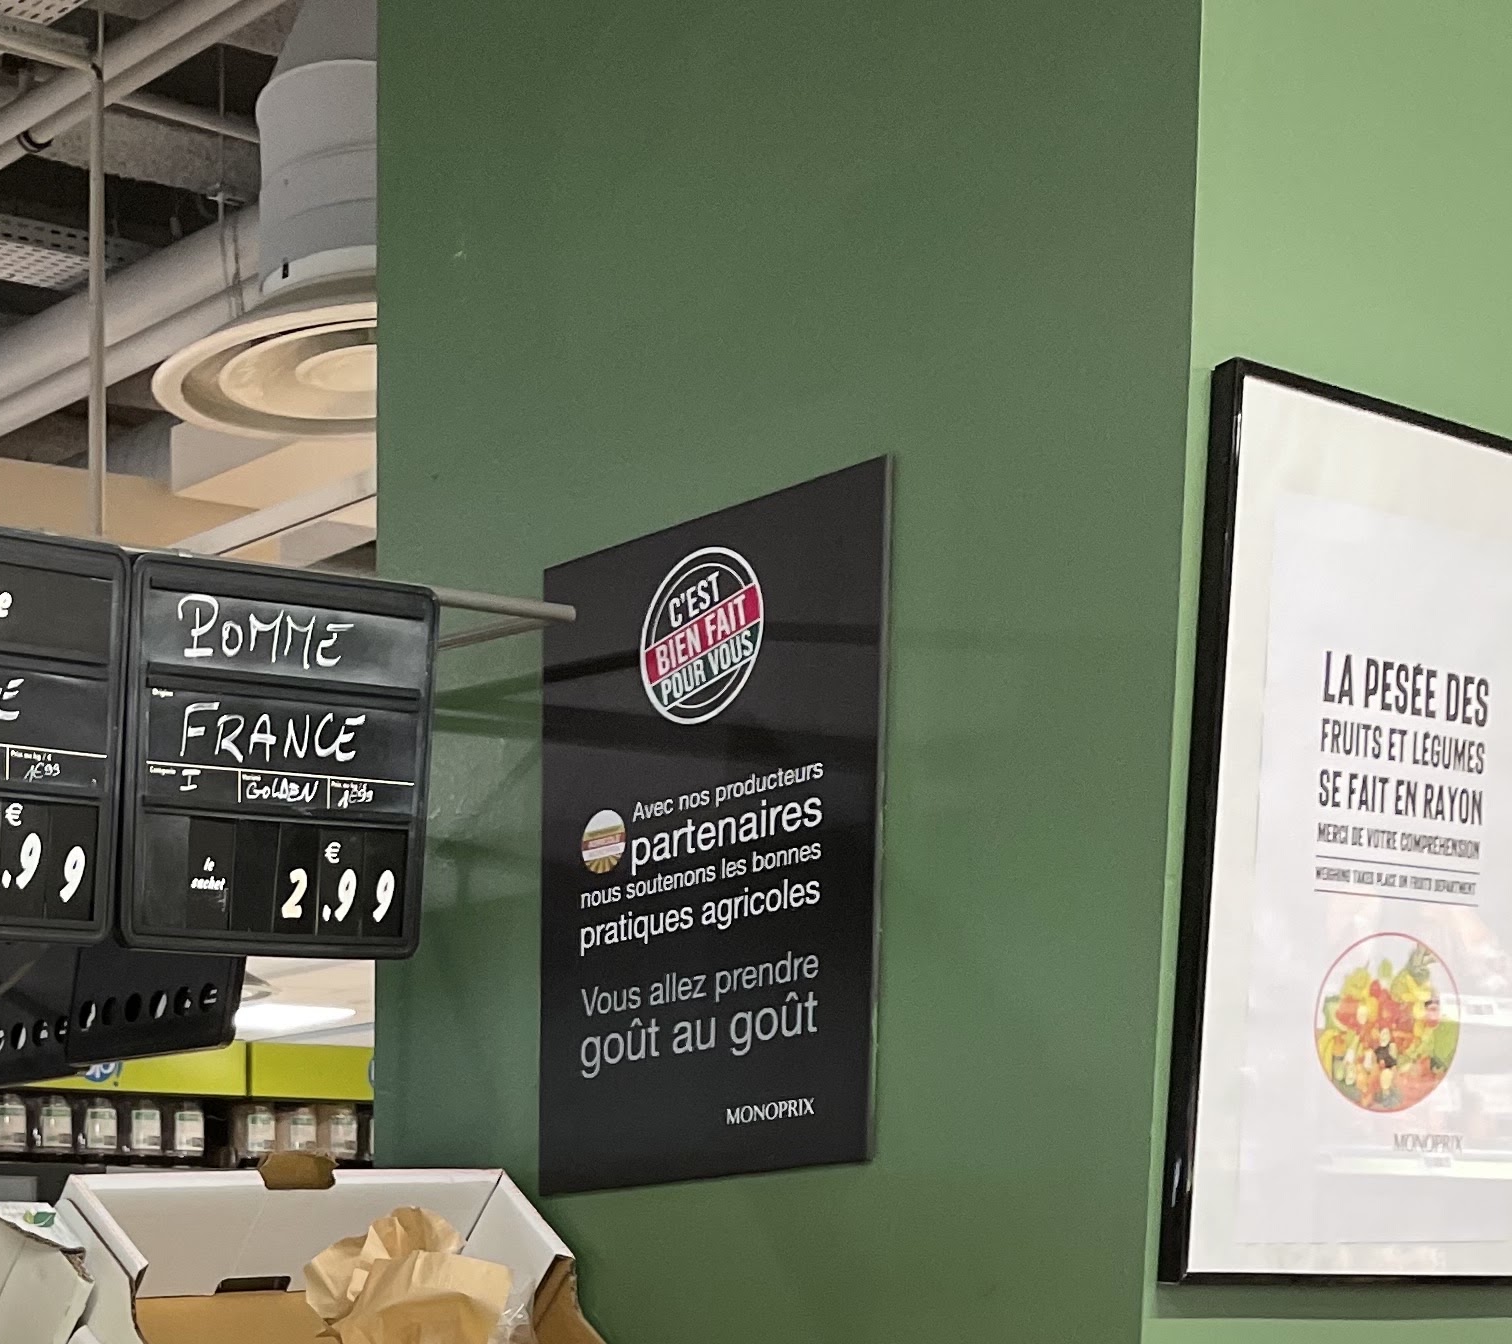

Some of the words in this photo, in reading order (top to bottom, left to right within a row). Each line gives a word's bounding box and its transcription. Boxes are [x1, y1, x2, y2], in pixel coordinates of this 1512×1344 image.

[668, 571, 720, 628] C'EST
[179, 593, 354, 670] POMME
[655, 625, 702, 677] BIEN
[704, 594, 749, 645] FAIT
[660, 658, 707, 706] POUR
[708, 629, 754, 678] VOUS
[1323, 650, 1354, 707] LA
[1364, 655, 1437, 720] PESÉE
[1445, 672, 1489, 728] DES
[179, 701, 366, 763] FRANCE
[1320, 718, 1382, 760] FRUITS
[1388, 728, 1409, 763] ET
[1412, 729, 1485, 775] LÉGUMES
[5, 802, 24, 827] €
[245, 777, 319, 803] GOLDEN
[631, 799, 674, 823] Avec
[678, 787, 711, 811] nos
[715, 761, 824, 802] producteurs
[1318, 769, 1341, 809] SE
[1348, 773, 1390, 814] FAIT
[1394, 779, 1417, 818] EN
[1423, 783, 1483, 827] RAYON
[203, 856, 215, 874] le
[324, 841, 341, 864] €
[630, 796, 824, 875] partenaires
[190, 873, 226, 892] sachet
[580, 886, 622, 909] nous
[626, 866, 717, 900] soutenons
[721, 857, 748, 880] les
[752, 841, 822, 873] bonnes
[580, 905, 694, 957] pratiques
[701, 879, 821, 931] agricoles
[581, 984, 642, 1017] Vous
[649, 972, 707, 1006] allez
[715, 950, 819, 1002] prendre
[580, 1018, 660, 1079] goût
[672, 1018, 717, 1055] au
[729, 991, 818, 1057] goût
[726, 1097, 815, 1125] MONOPRIX
[1393, 1132, 1463, 1153] MONOPRIX
